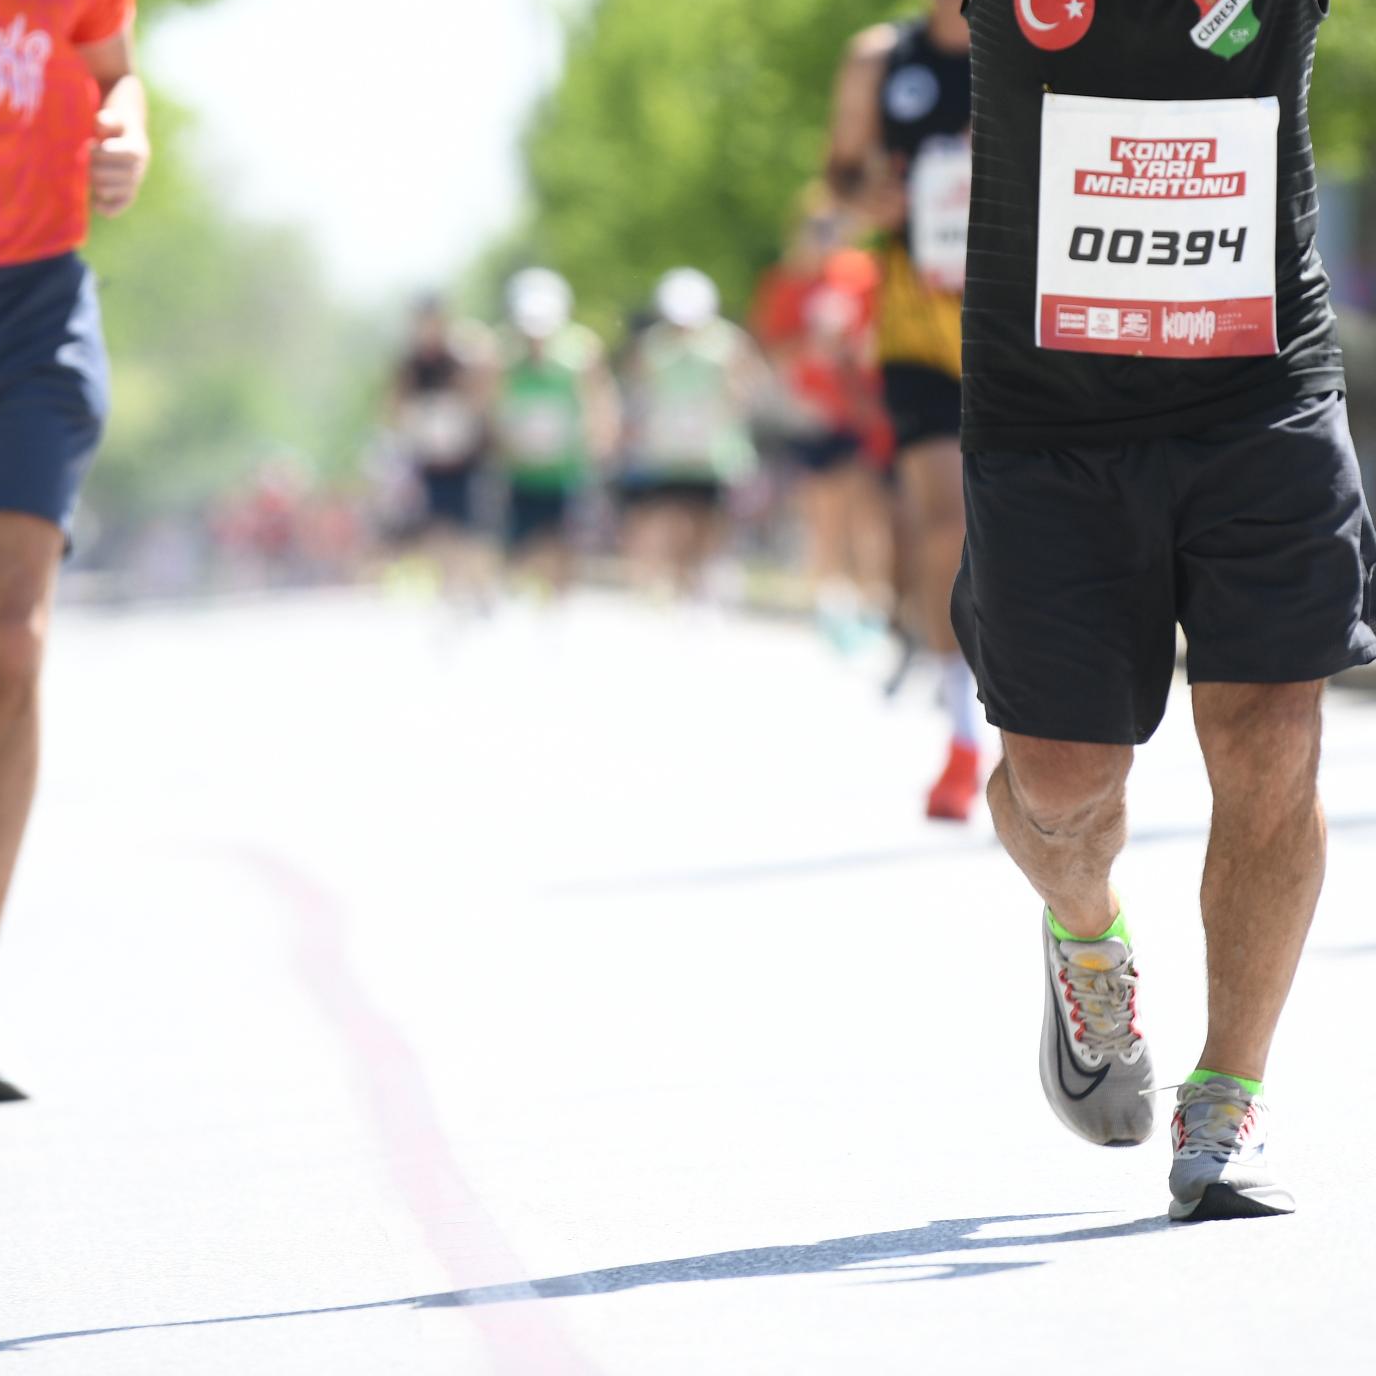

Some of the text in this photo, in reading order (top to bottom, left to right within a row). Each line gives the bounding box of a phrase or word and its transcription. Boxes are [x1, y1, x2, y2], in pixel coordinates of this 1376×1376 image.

[1116, 141, 1211, 162] KONYA
[1130, 159, 1195, 179] YARI
[1083, 174, 1240, 196] MARATONU
[1068, 226, 1248, 266] 00394
